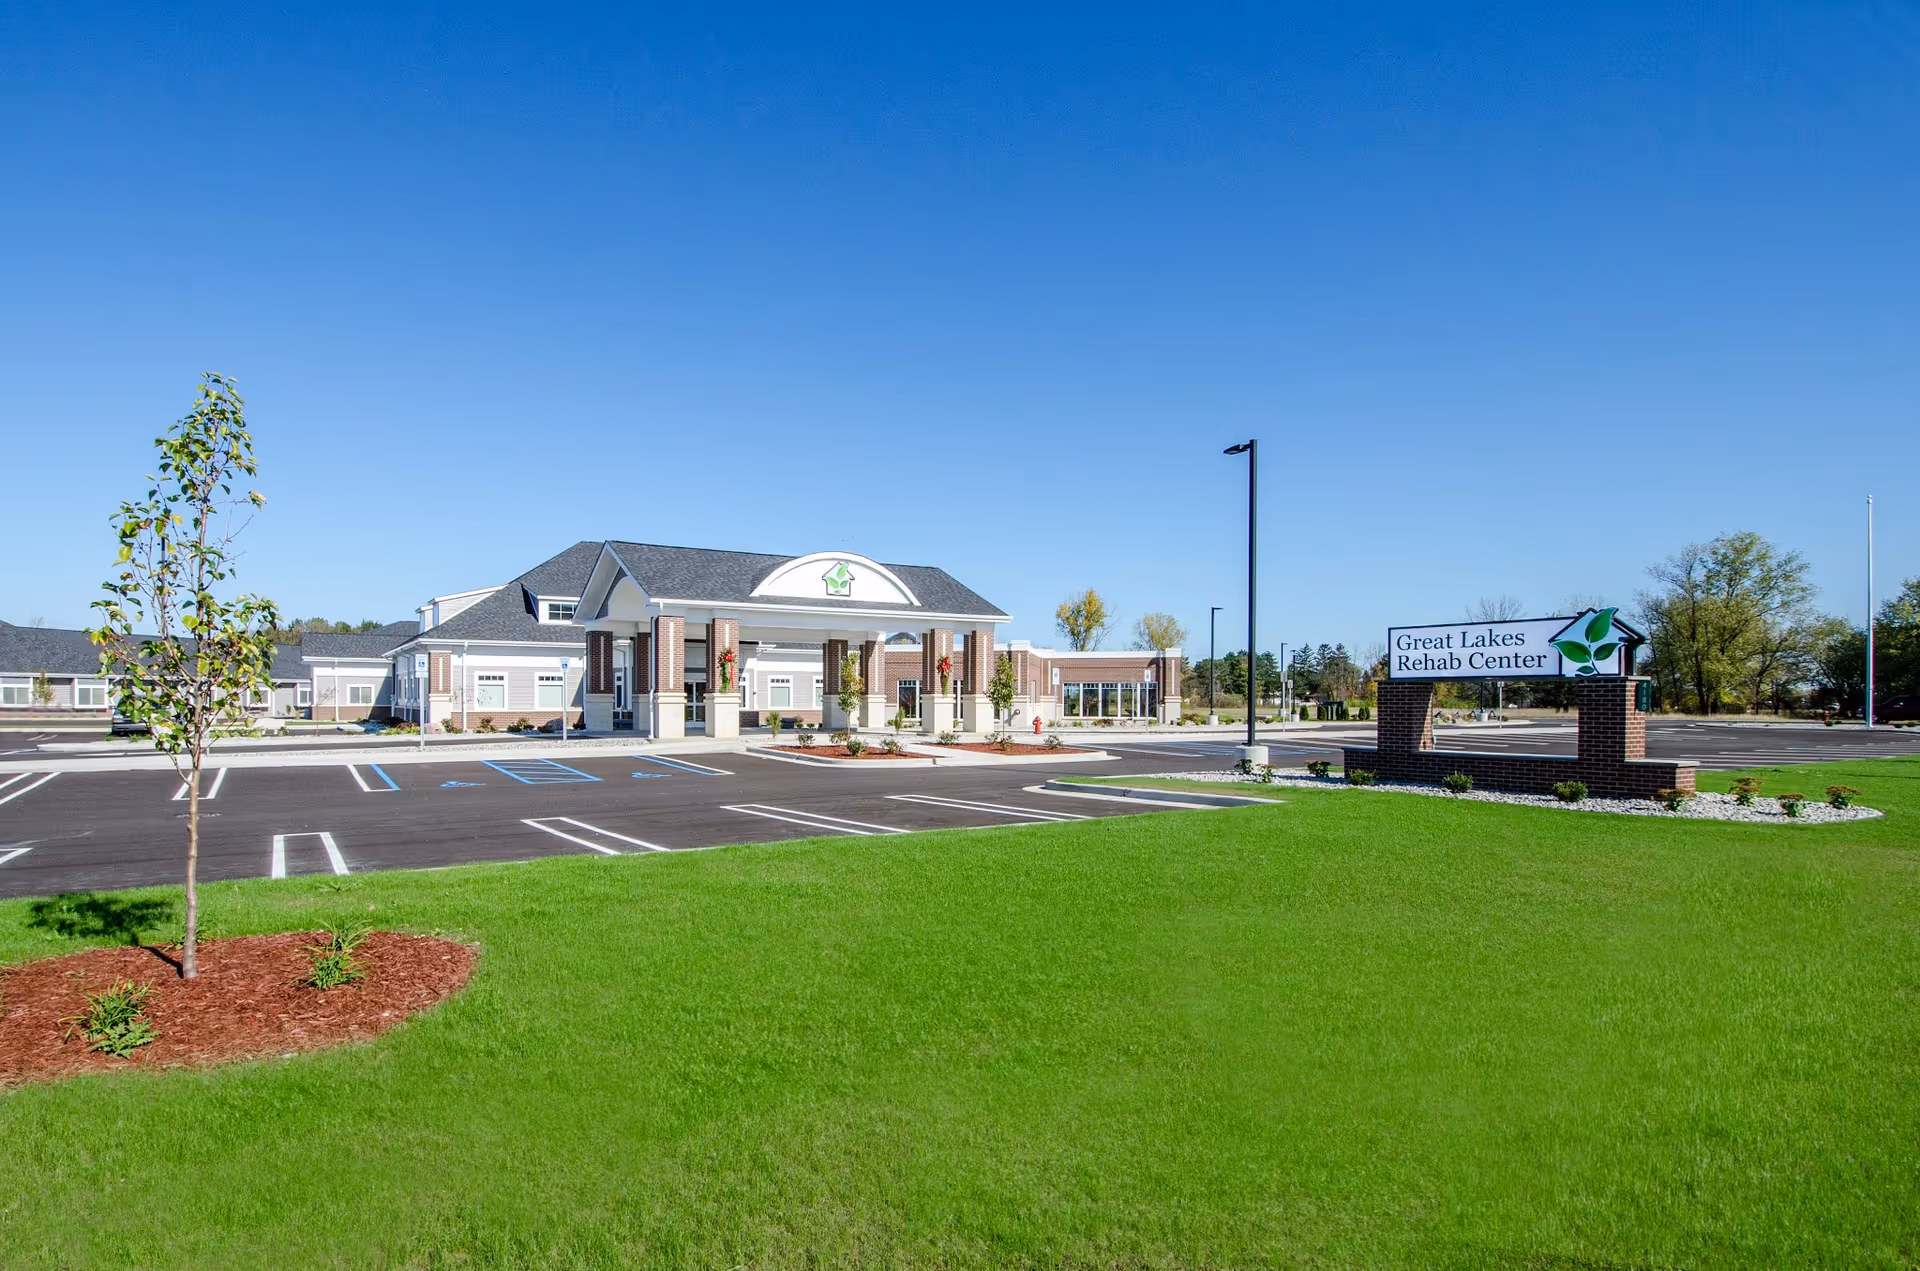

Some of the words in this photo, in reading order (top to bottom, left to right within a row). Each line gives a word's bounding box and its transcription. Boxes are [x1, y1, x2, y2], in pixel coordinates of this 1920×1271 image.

[1396, 633, 1453, 651] Great
[1460, 628, 1525, 648] Lakes
[1397, 652, 1462, 671] Rehab
[1468, 651, 1547, 670] Center
